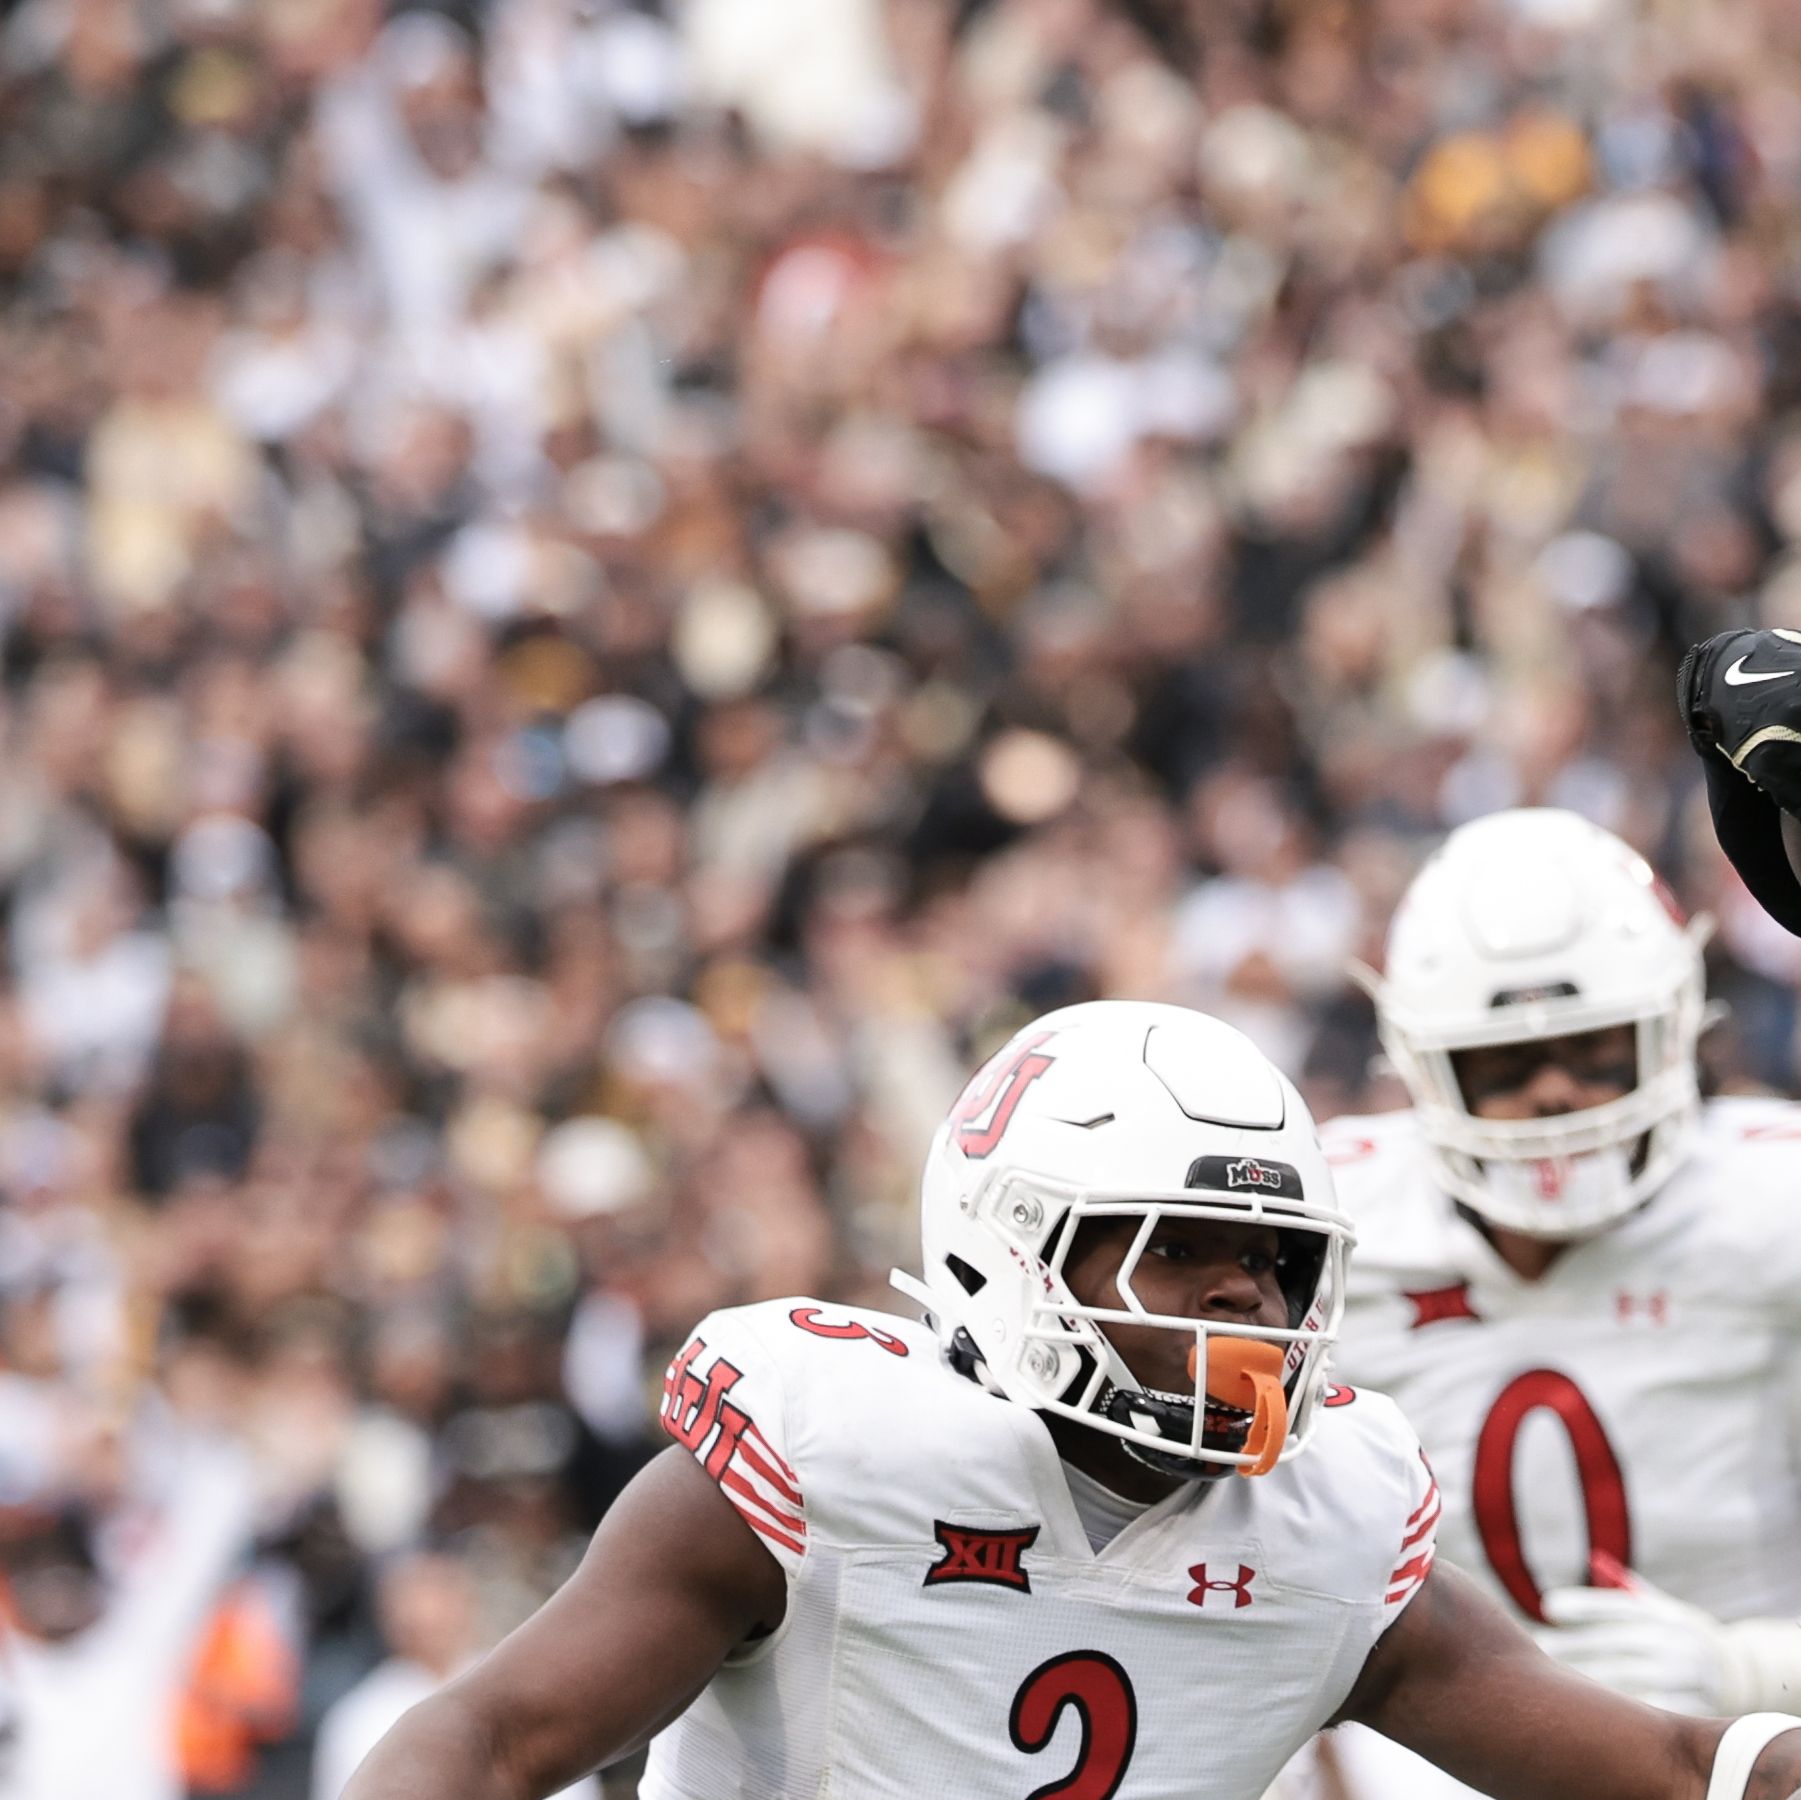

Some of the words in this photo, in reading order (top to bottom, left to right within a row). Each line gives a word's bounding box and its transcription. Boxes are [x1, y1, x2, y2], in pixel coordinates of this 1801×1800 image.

[1230, 1163, 1281, 1187] MUSS
[1472, 1368, 1635, 1624] 0
[923, 1520, 1040, 1593] XII
